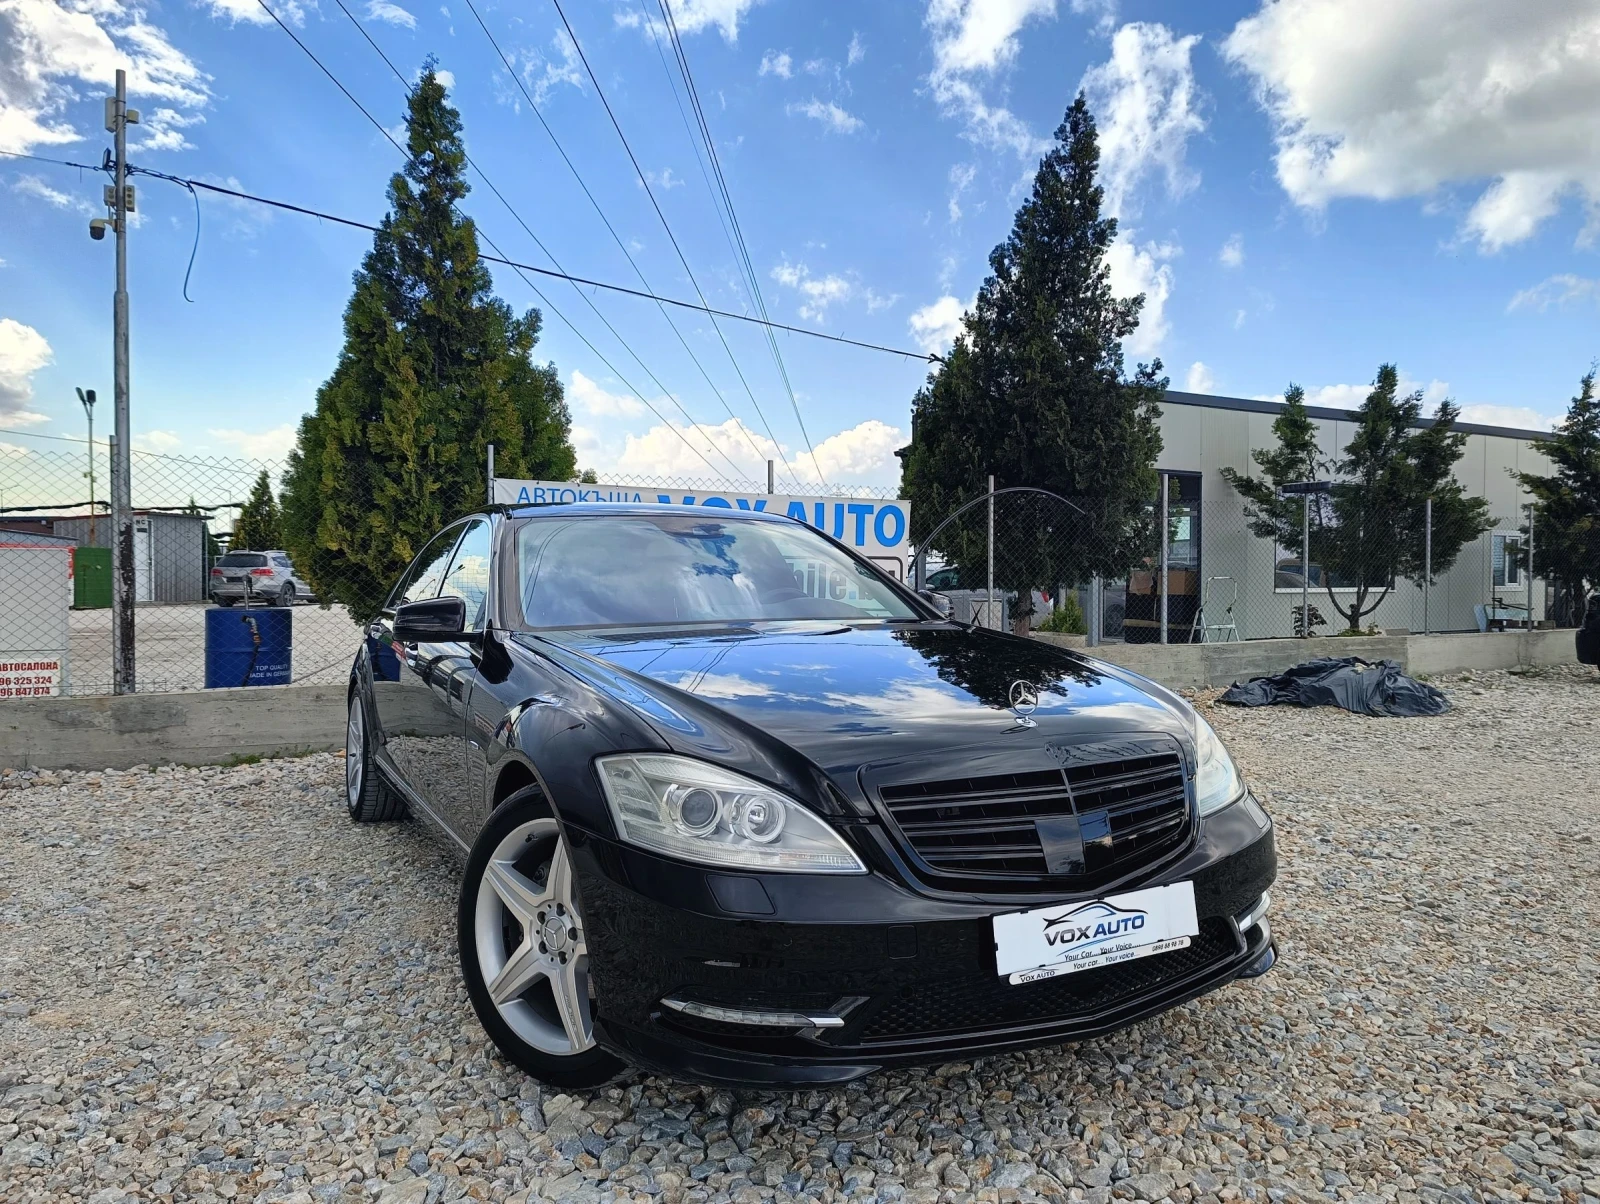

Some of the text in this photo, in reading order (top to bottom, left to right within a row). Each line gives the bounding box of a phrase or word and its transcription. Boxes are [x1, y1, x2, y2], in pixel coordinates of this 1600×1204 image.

[0, 661, 59, 672] ВТОСАЛОНА
[13, 676, 32, 685] 325
[34, 676, 52, 685] 324
[15, 687, 32, 696] 847
[1044, 915, 1145, 946] VOX AUTO
[1073, 960, 1088, 970] Your
[1105, 955, 1119, 963] Your
[1020, 970, 1056, 983] VOX AUTO
